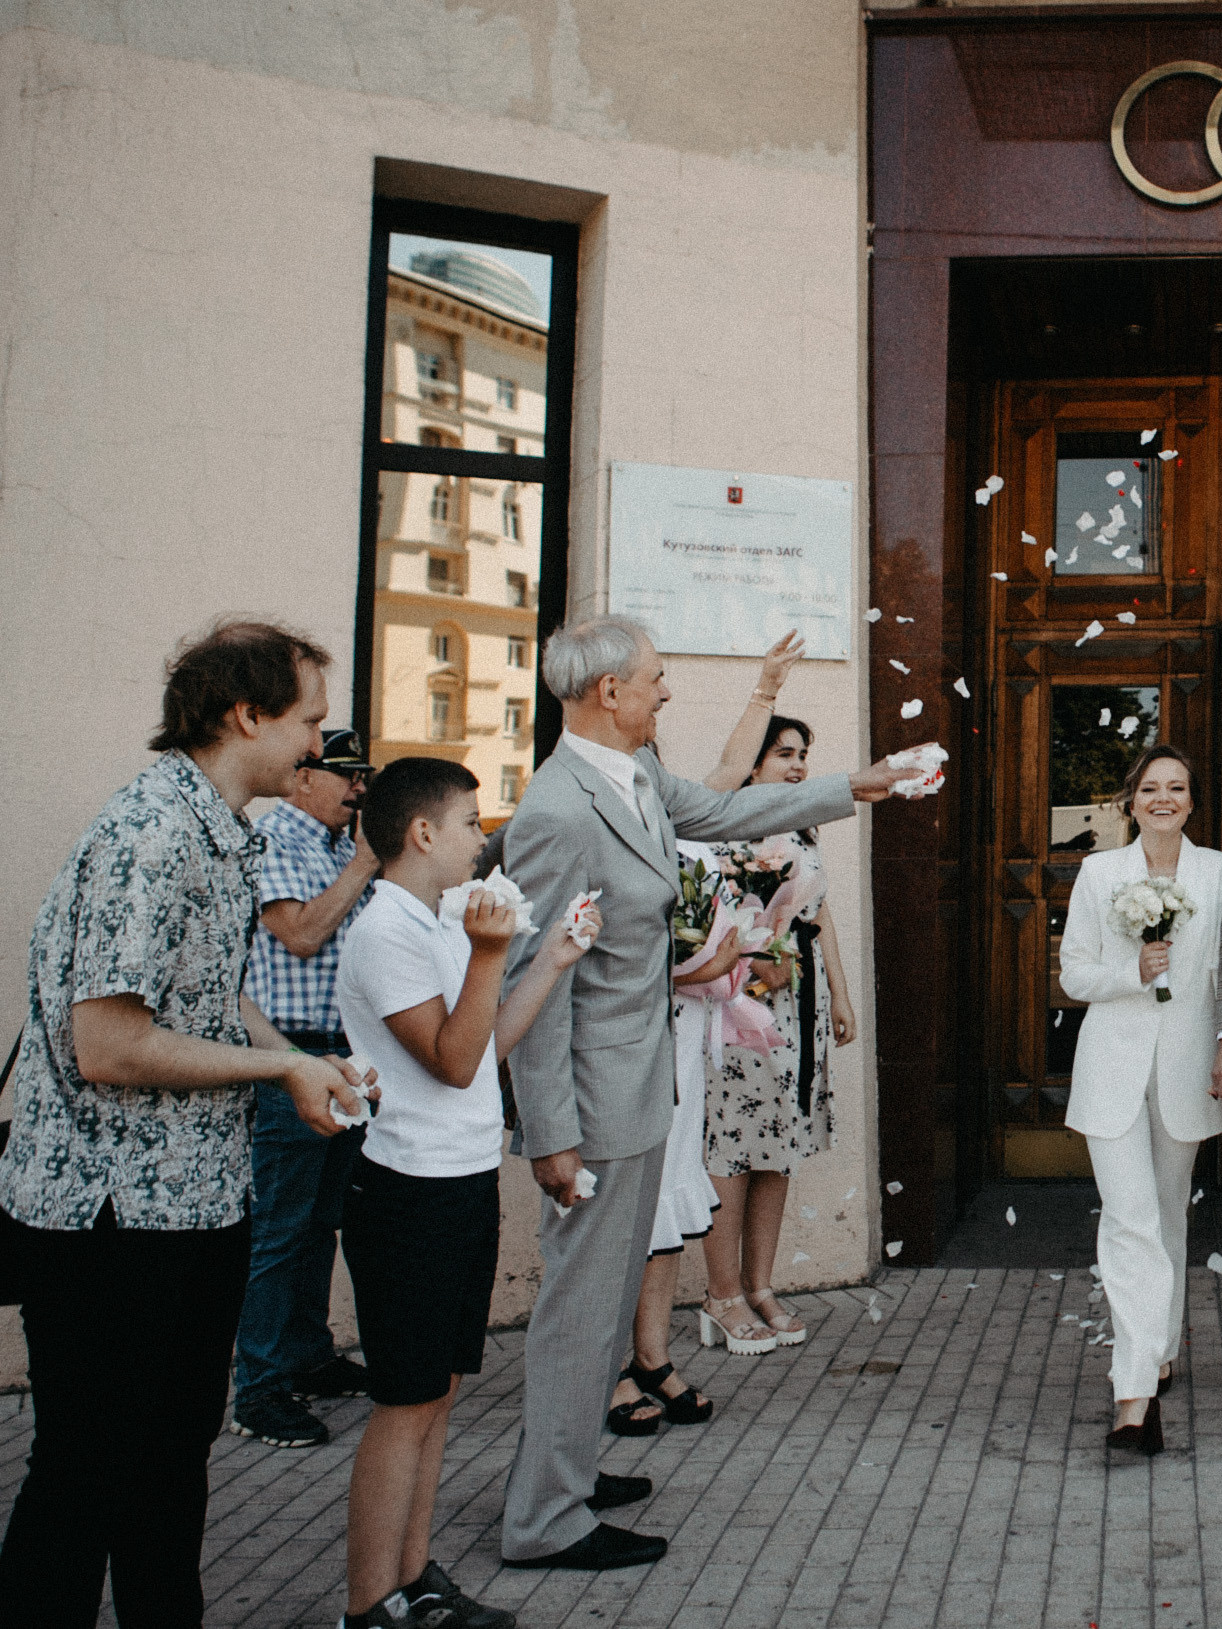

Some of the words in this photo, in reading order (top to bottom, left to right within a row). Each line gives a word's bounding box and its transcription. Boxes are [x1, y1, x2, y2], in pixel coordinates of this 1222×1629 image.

[662, 539, 736, 553] Кутузовский
[740, 545, 773, 556] отдел
[776, 547, 803, 558] ЗАГС
